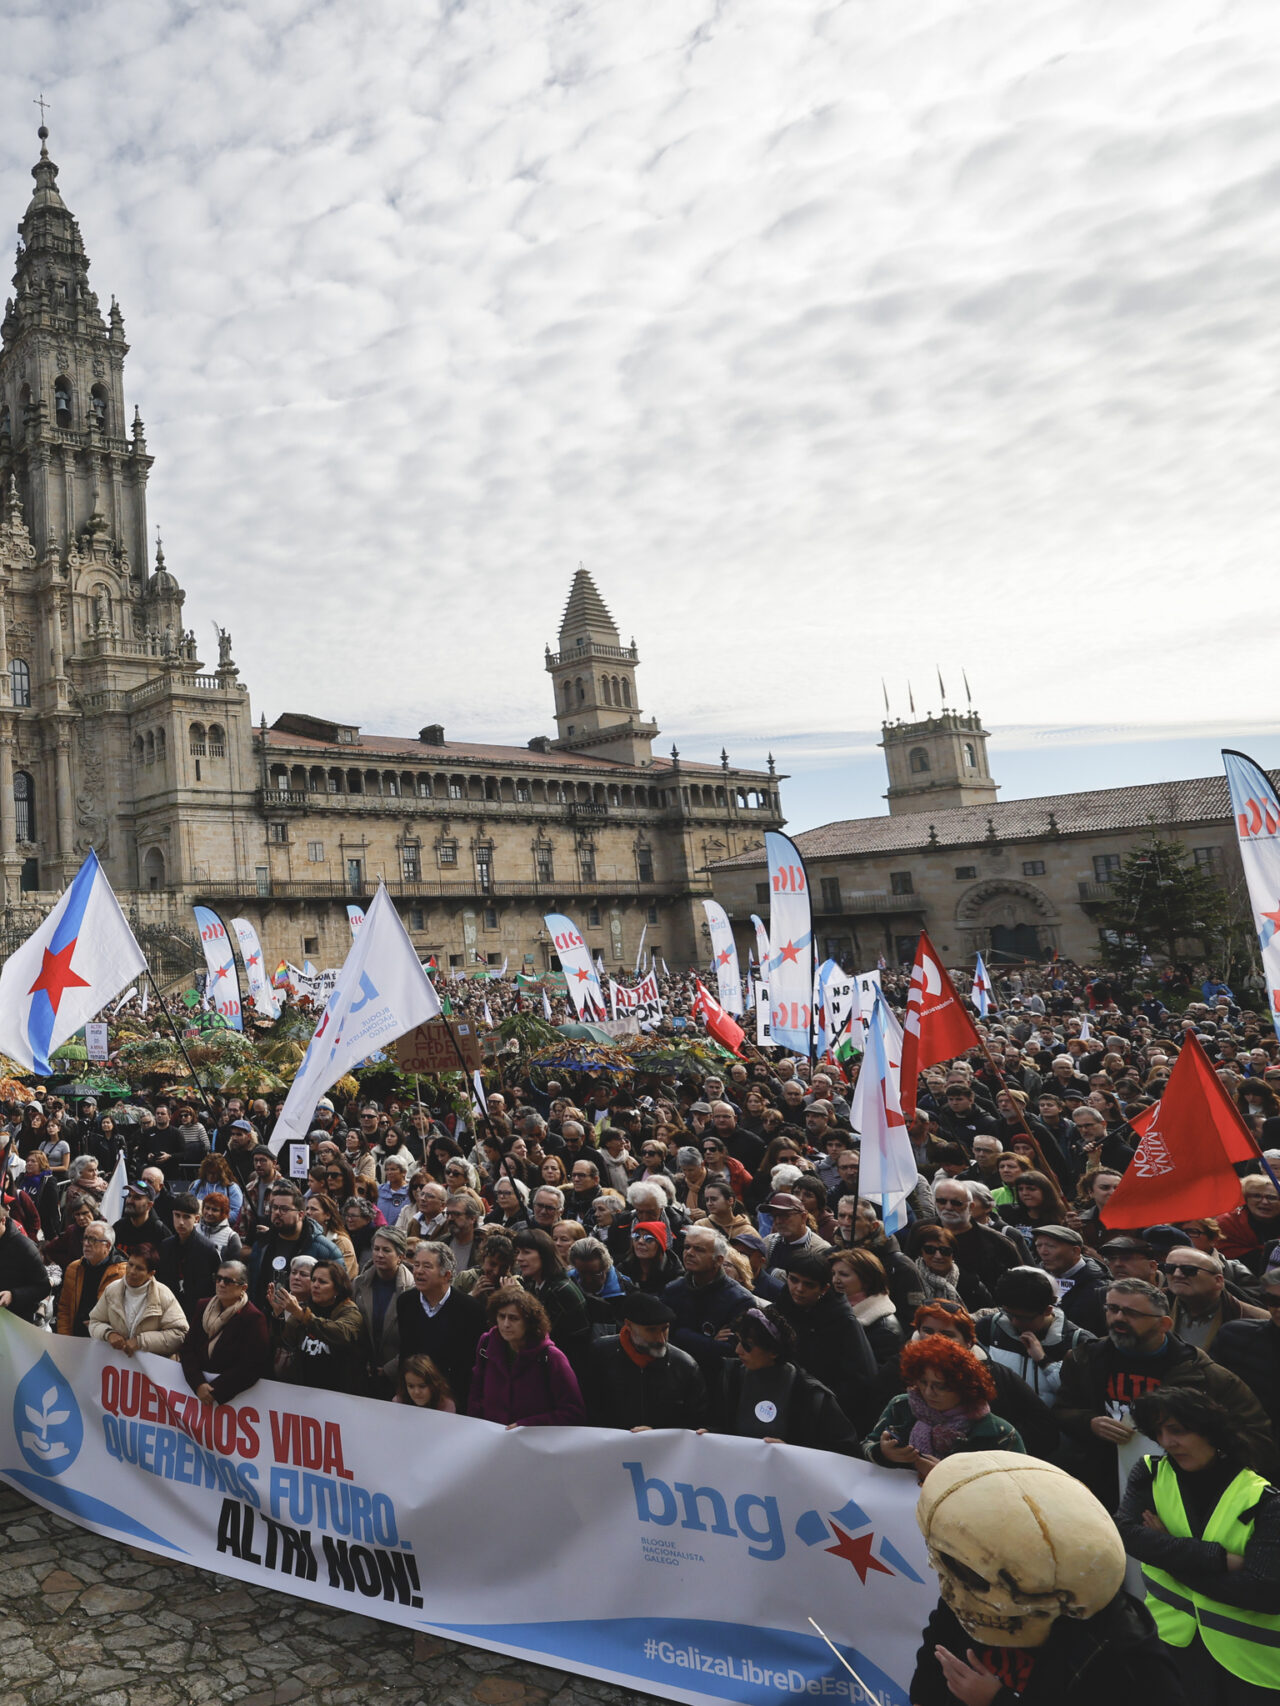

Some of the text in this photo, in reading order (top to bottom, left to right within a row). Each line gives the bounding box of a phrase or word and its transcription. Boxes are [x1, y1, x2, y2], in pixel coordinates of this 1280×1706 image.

[616, 977, 658, 1008] ALTRI
[1146, 1131, 1174, 1175] MINA
[101, 1365, 354, 1481] QUEREMOS VIDA.
[102, 1413, 413, 1550] QUEREMOS FUTURO.
[622, 1461, 786, 1562] bng
[216, 1497, 424, 1610] ALTRI NON!
[640, 1536, 677, 1550] BLOQUE
[641, 1545, 705, 1563] NACIONALISTA
[643, 1553, 680, 1567] GALEGO
[643, 1637, 900, 1706] #GalizaLibreDeEspoli
